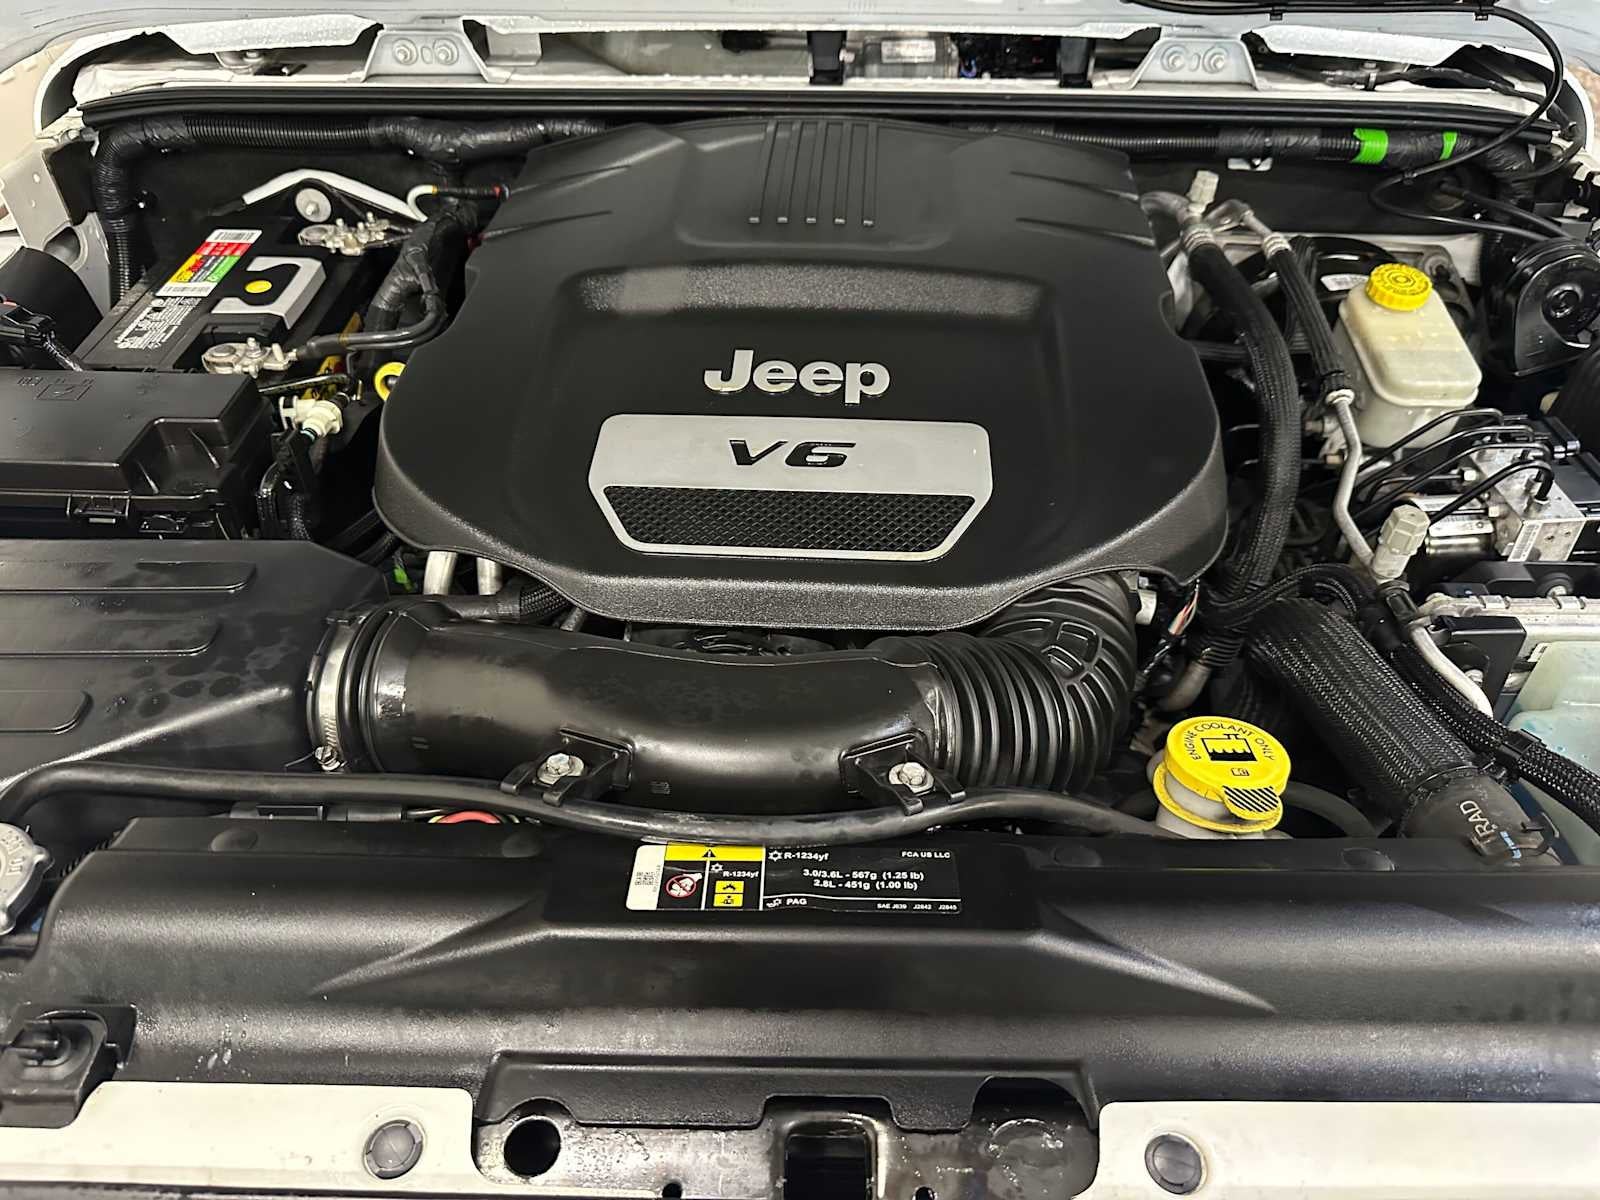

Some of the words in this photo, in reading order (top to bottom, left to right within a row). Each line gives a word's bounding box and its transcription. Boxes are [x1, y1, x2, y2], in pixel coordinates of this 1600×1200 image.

[704, 350, 891, 404] Jeep
[729, 439, 857, 467] V6
[1184, 730, 1202, 760] ENGINE
[1194, 722, 1255, 737] COOLANT
[1255, 737, 1276, 761] ONLY
[784, 852, 829, 861] R-1234yf
[934, 851, 951, 859] LLC
[802, 869, 844, 879] 3.0/3.6L
[852, 871, 877, 881] 567g
[882, 871, 908, 881] (1.25
[910, 872, 925, 881] lb)
[813, 879, 837, 888] 2.8L
[845, 881, 871, 890] 451g
[875, 881, 902, 890] (1.00
[903, 882, 918, 891] lb)
[786, 898, 808, 906] PAG
